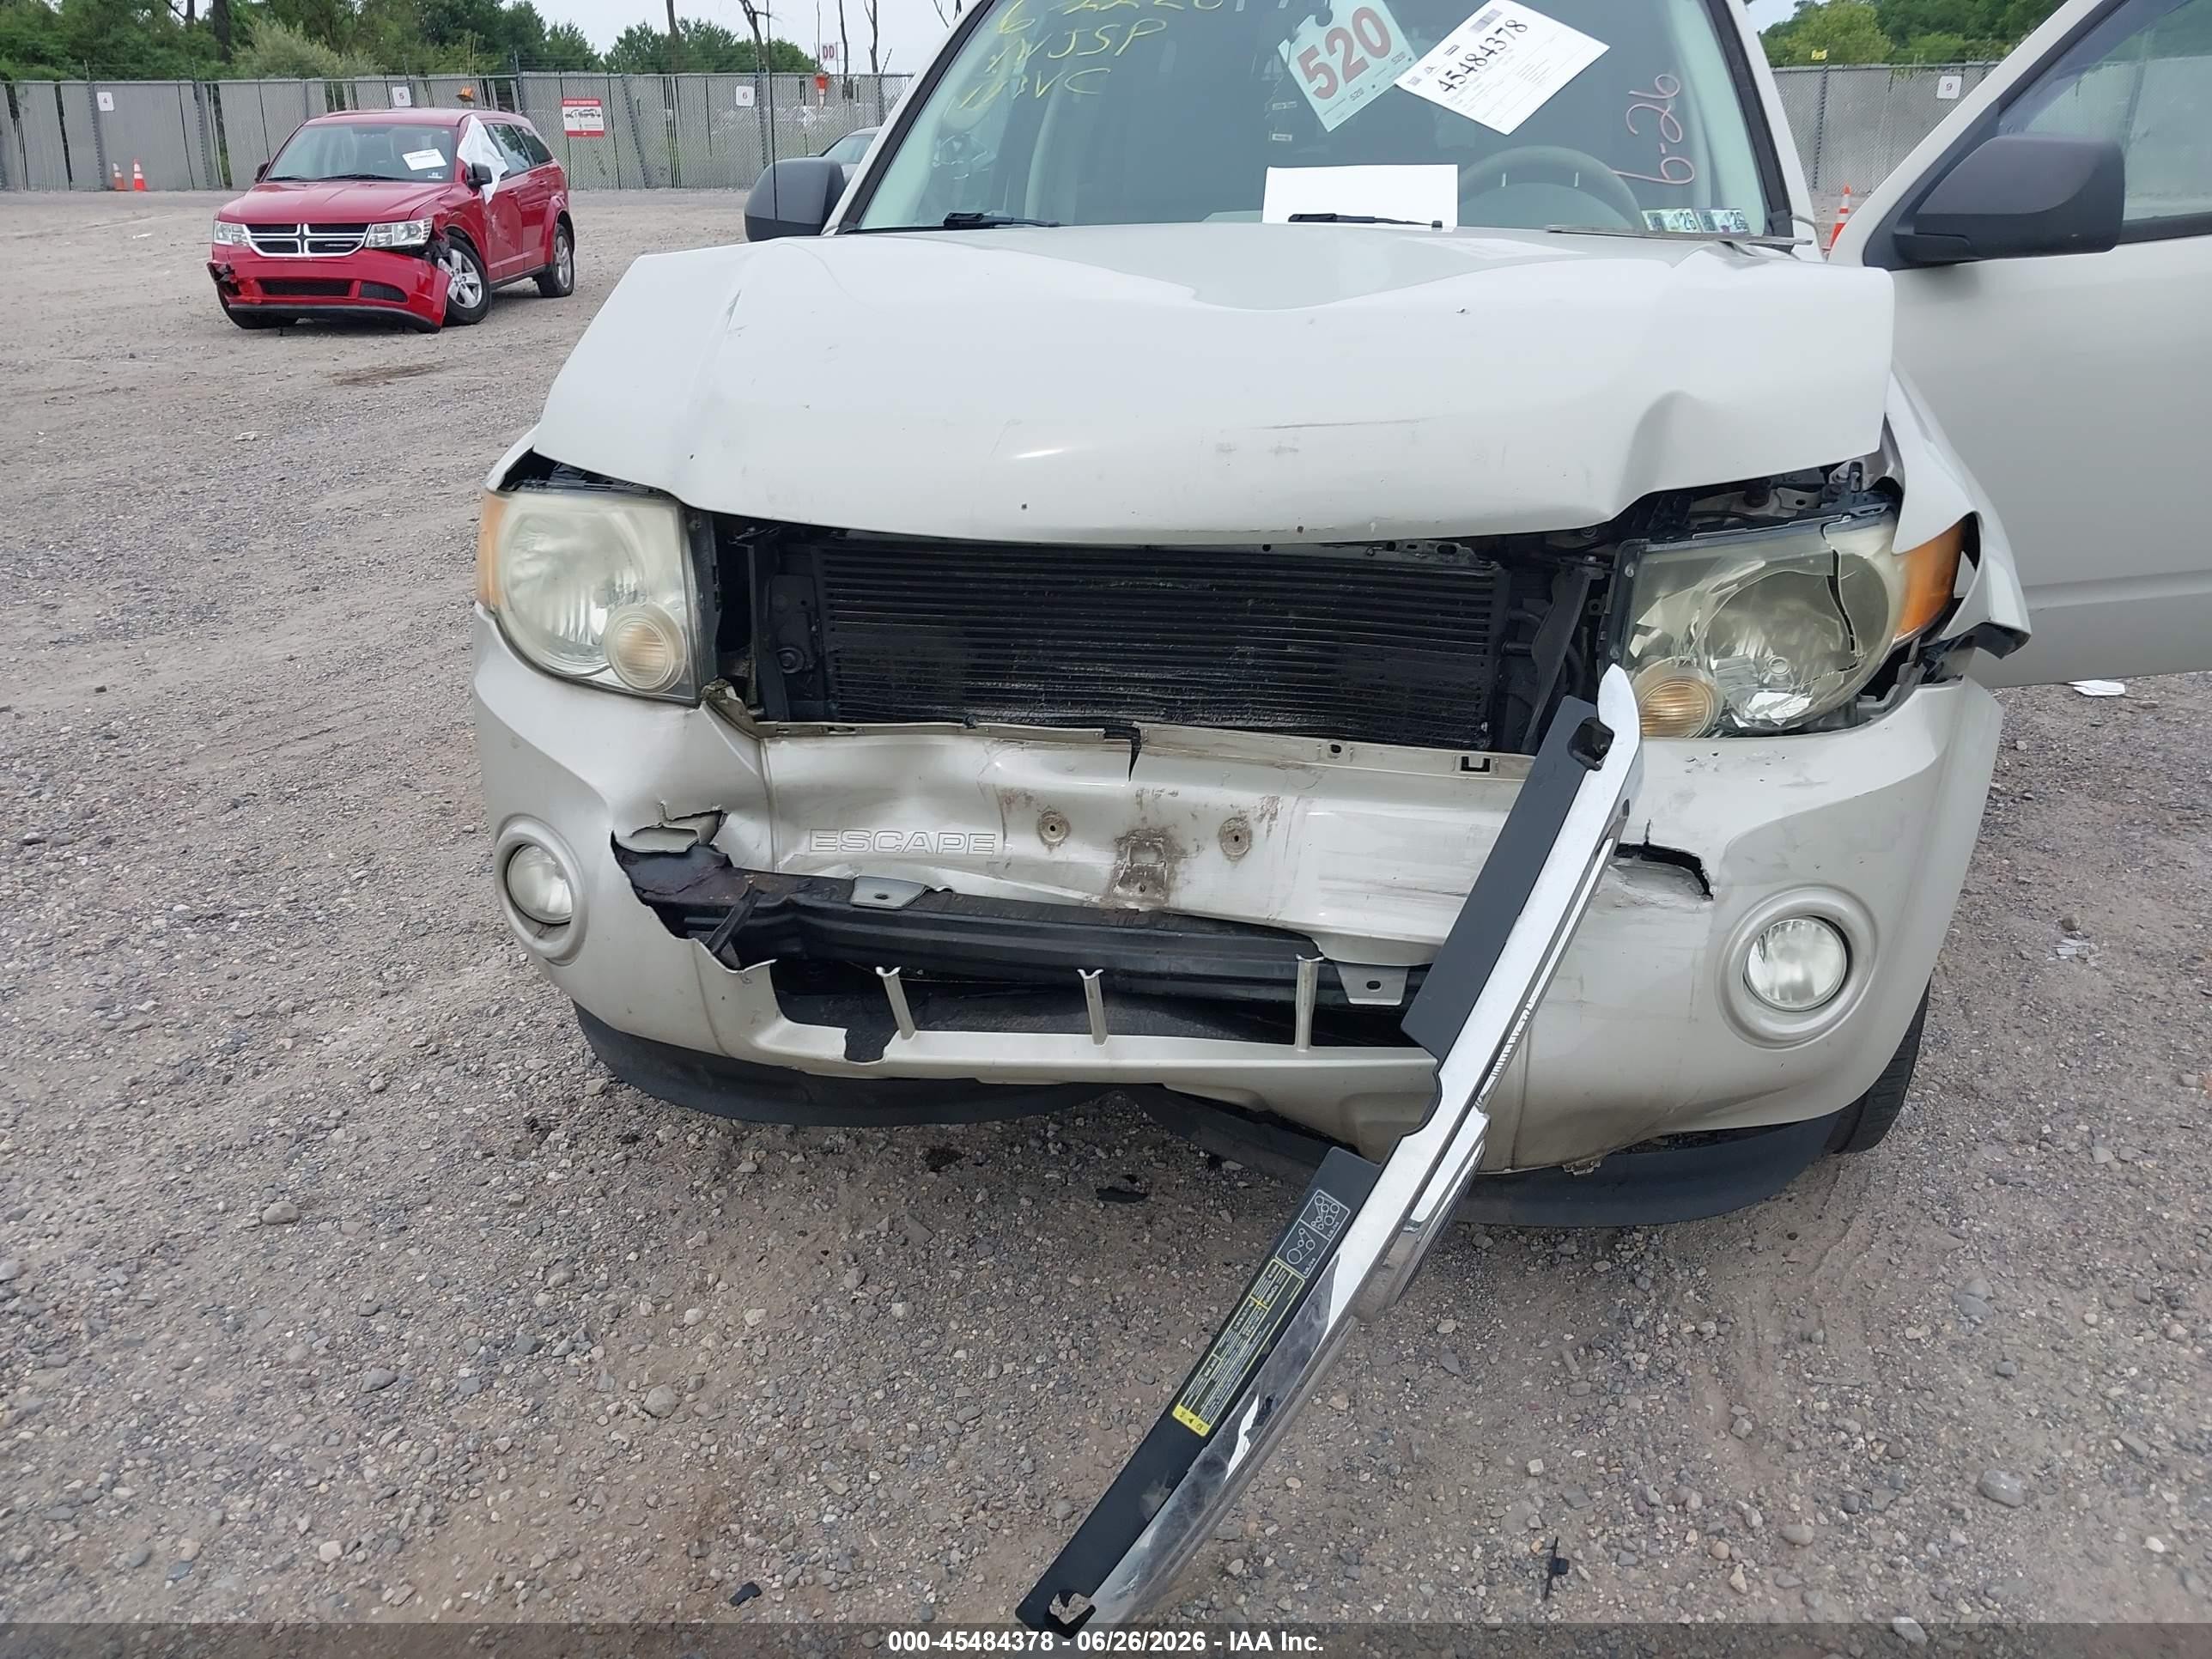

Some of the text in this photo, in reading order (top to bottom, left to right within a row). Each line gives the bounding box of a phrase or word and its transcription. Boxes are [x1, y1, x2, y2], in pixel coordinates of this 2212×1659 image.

[1297, 6, 1392, 100] 520
[1437, 19, 1528, 93] 45484378
[1612, 73, 1696, 185] 6-26
[808, 828, 997, 856] ESCAPE
